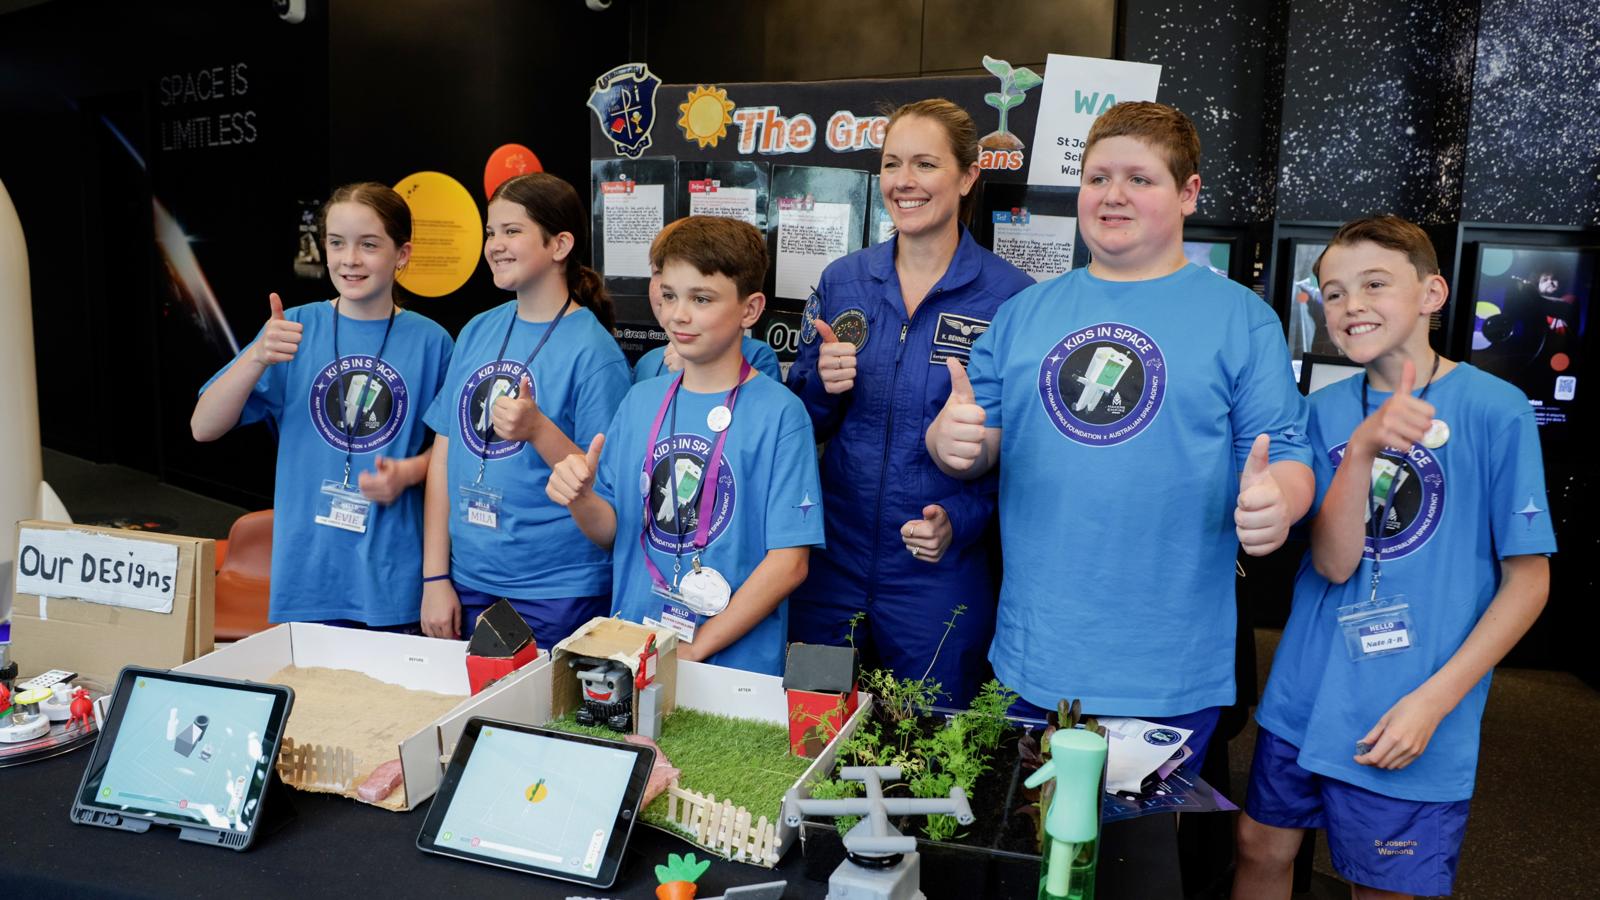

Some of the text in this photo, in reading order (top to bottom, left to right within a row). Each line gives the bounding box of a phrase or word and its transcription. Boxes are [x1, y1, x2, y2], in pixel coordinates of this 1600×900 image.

[160, 62, 248, 106] SPACE IS
[1074, 90, 1117, 116] WA
[162, 110, 257, 150] LIMITLESS
[734, 107, 815, 153] The
[828, 112, 888, 151] Gre
[1057, 137, 1086, 148] St Jo
[1064, 152, 1081, 162] Sch
[1061, 165, 1081, 176] War
[624, 328, 647, 340] Green
[648, 329, 671, 341] Guar
[767, 322, 801, 353] Ou
[1063, 327, 1153, 354] KIDS IN SPACE
[351, 358, 363, 367] IN
[364, 359, 398, 382] SACE
[501, 363, 513, 372] IN
[1046, 387, 1058, 412] THOMAS
[1055, 411, 1069, 426] SPACE
[1065, 423, 1102, 440] FOUNDATION
[1109, 418, 1142, 439] AUSTRALIAN
[1140, 401, 1155, 420] SPACE
[1149, 375, 1159, 403] AGENCY
[679, 438, 691, 449] IN
[722, 492, 731, 515] AGENCY
[335, 511, 359, 525] EVIE
[470, 511, 493, 525] MILA
[1381, 535, 1417, 553] AUSTRALIAN
[1416, 519, 1431, 538] SPACE
[1428, 492, 1438, 519] AGENCY
[20, 545, 73, 584] Our
[671, 606, 689, 617] HELLO
[1369, 622, 1394, 632] HELLO
[1366, 638, 1385, 648] Nate
